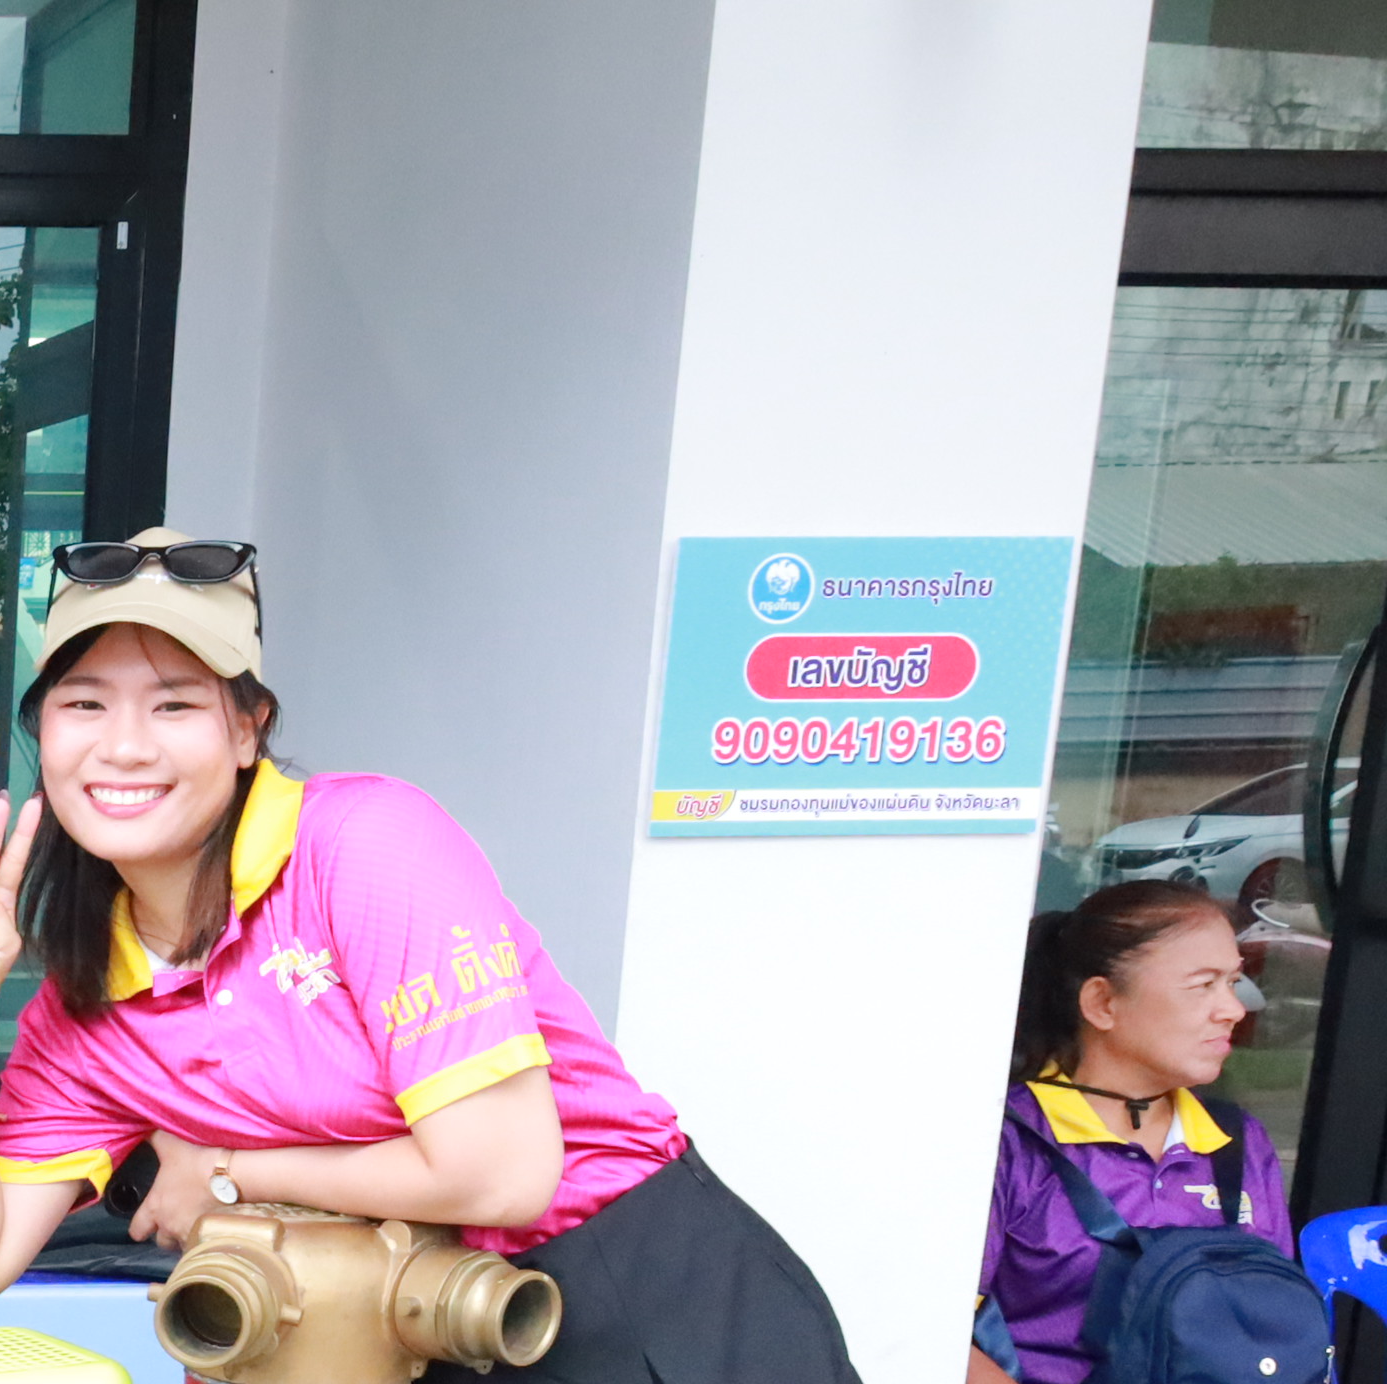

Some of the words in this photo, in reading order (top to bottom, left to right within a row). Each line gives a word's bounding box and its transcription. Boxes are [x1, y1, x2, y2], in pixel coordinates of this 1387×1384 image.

[821, 572, 993, 605] ธนาคารกรุงไทย
[787, 645, 932, 694] เลขบัญชี
[711, 716, 1005, 764] 9090419136
[675, 793, 724, 818] บัญชี
